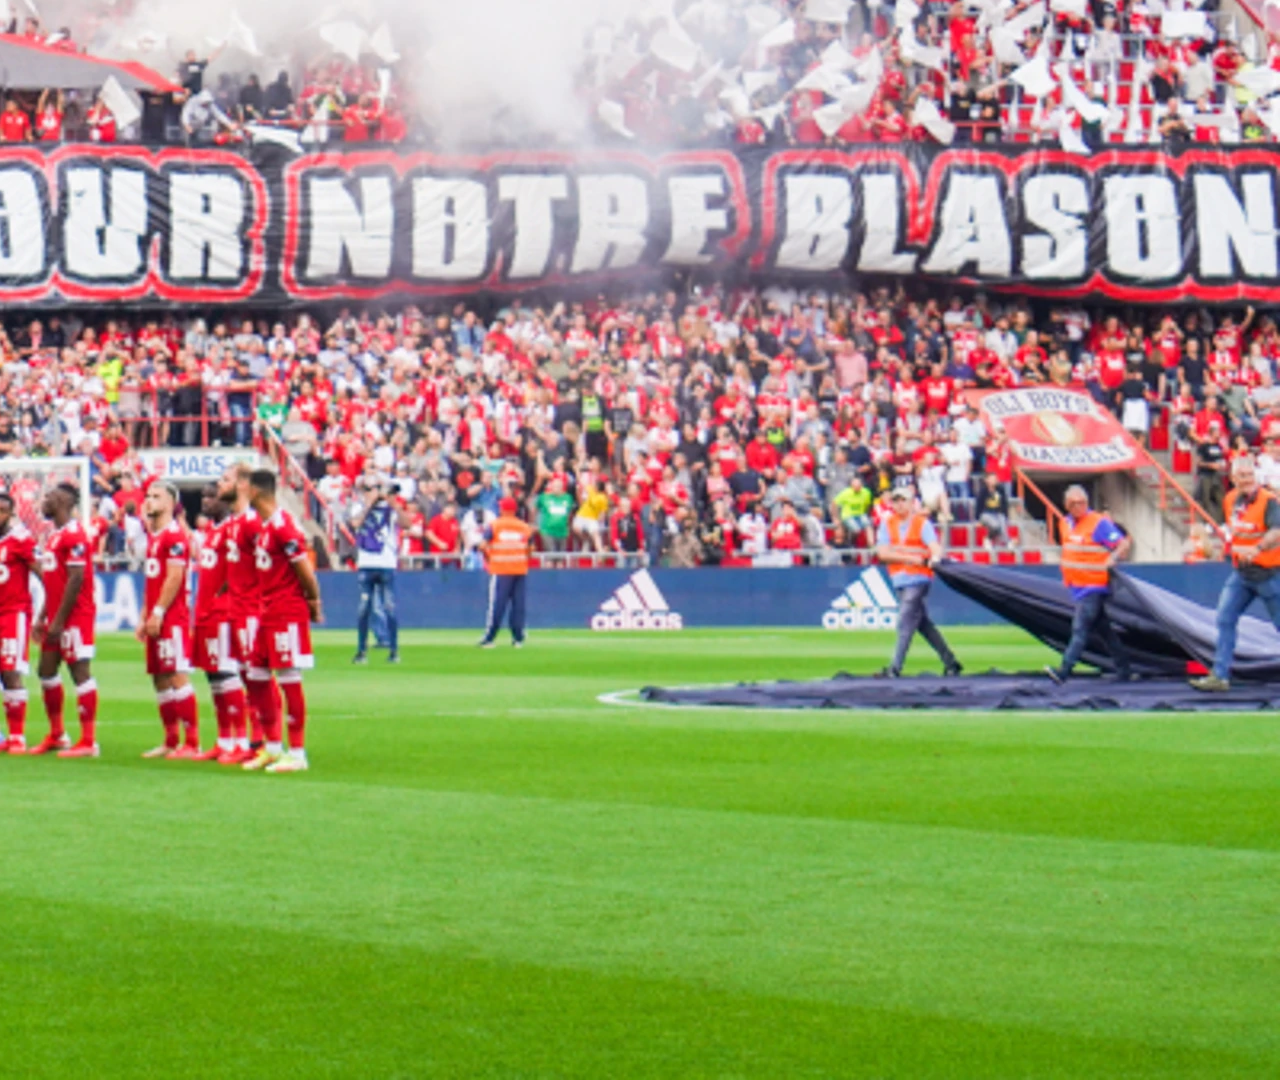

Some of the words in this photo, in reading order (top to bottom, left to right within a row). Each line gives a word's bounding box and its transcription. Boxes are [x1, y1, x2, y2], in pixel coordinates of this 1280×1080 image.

[306, 172, 730, 279] NOTRE
[776, 172, 1278, 280] BLASON
[169, 456, 225, 475] MAES
[590, 610, 683, 630] adidas
[822, 610, 899, 630] adida
